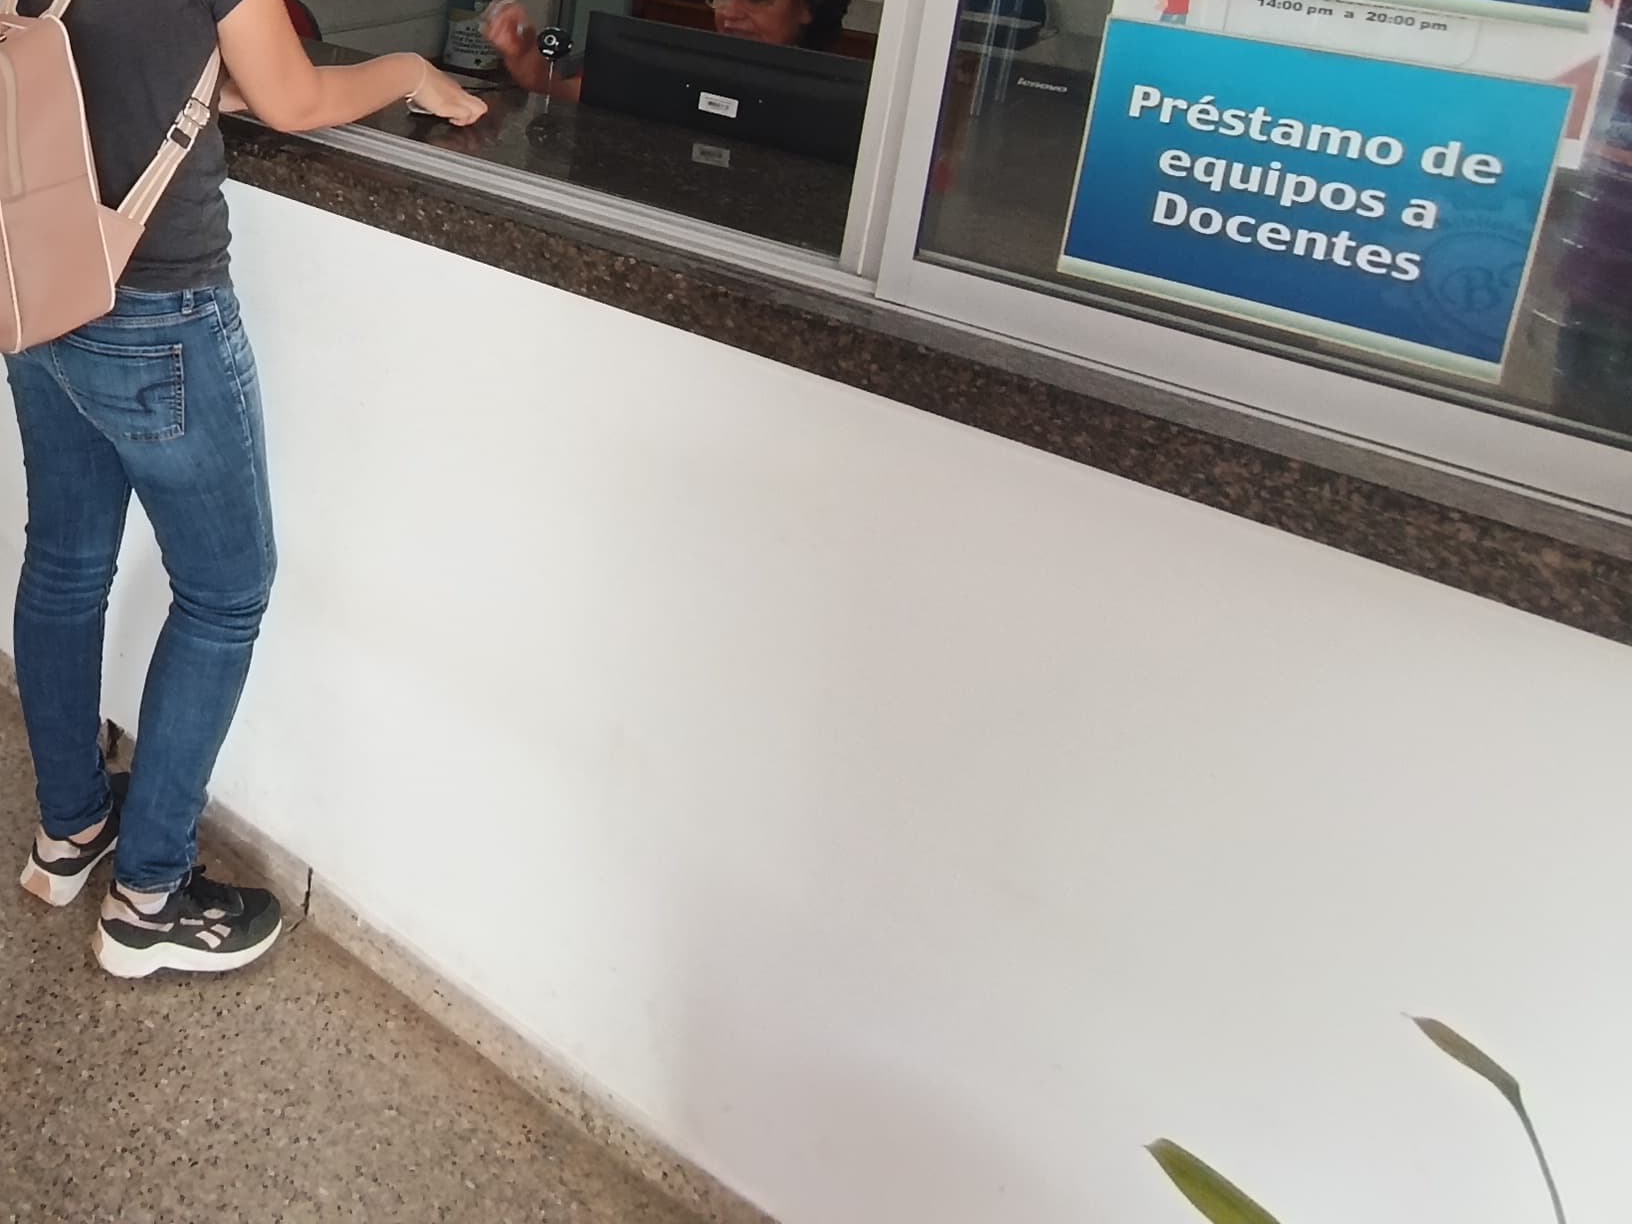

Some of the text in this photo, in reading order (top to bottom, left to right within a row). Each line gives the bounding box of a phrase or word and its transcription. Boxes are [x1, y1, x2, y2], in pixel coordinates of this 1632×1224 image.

[1306, 5, 1334, 16] pm
[1344, 10, 1354, 19] a
[1365, 11, 1416, 27] 20:00
[1419, 20, 1449, 31] pm
[1128, 83, 1504, 185] Préstamo de
[1158, 147, 1438, 231] equipos a
[1152, 190, 1423, 282] Docentes
